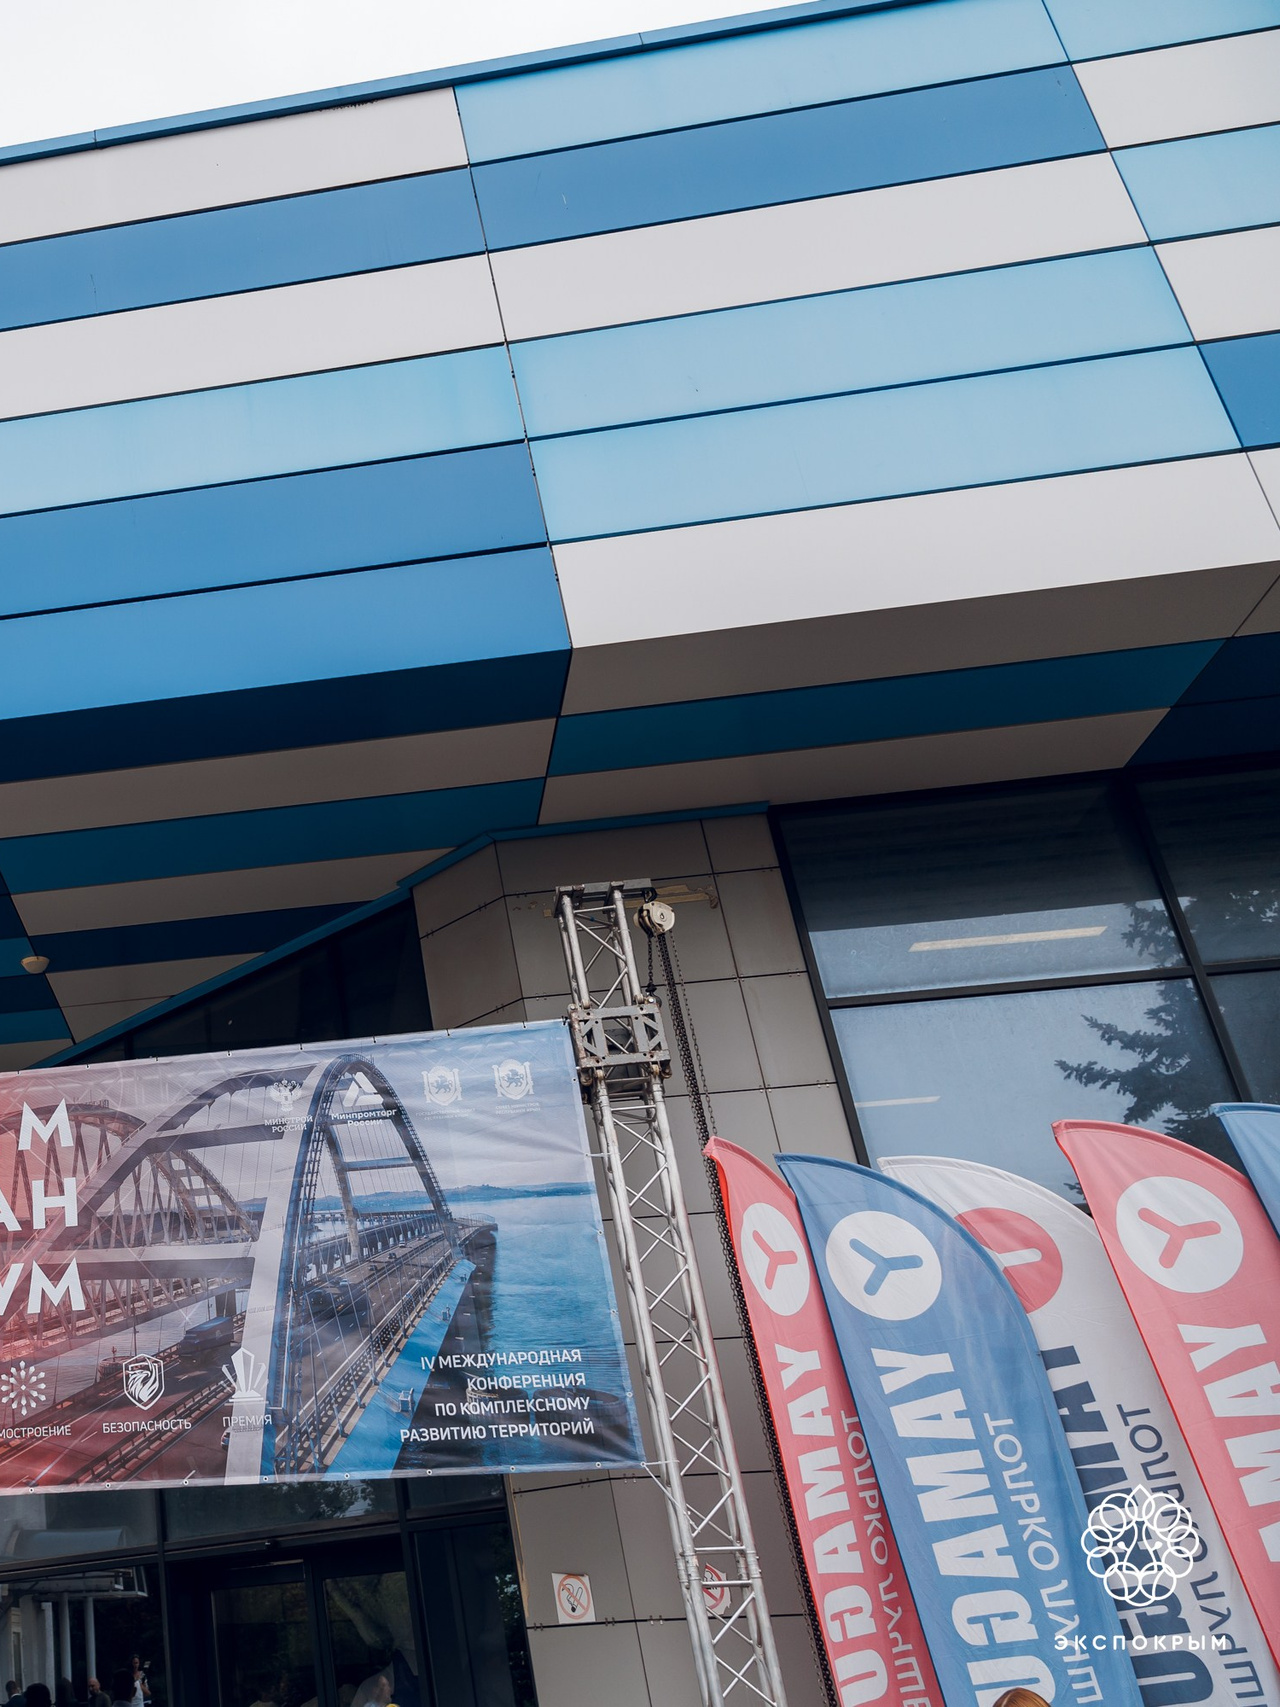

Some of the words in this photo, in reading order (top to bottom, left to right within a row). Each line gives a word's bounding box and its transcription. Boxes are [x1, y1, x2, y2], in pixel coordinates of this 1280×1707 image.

[330, 1109, 397, 1120] Минпромторг
[347, 1119, 383, 1127] России
[421, 1356, 436, 1370] IV
[439, 1349, 582, 1369] МЕЖДУНАРОДНАЯ
[467, 1373, 586, 1391] КОНФЕРЕНЦИЯ
[435, 1402, 457, 1416] ПО
[460, 1397, 590, 1415] КОМПЛЕКСНОМУ
[102, 1418, 192, 1434] БЕЗОПАСНОСТЬ
[222, 1414, 273, 1428] ПРЕМИЯ
[400, 1424, 486, 1442] РАЗВИТИЮ
[489, 1417, 595, 1438] ТЕРРИТОРИЙ
